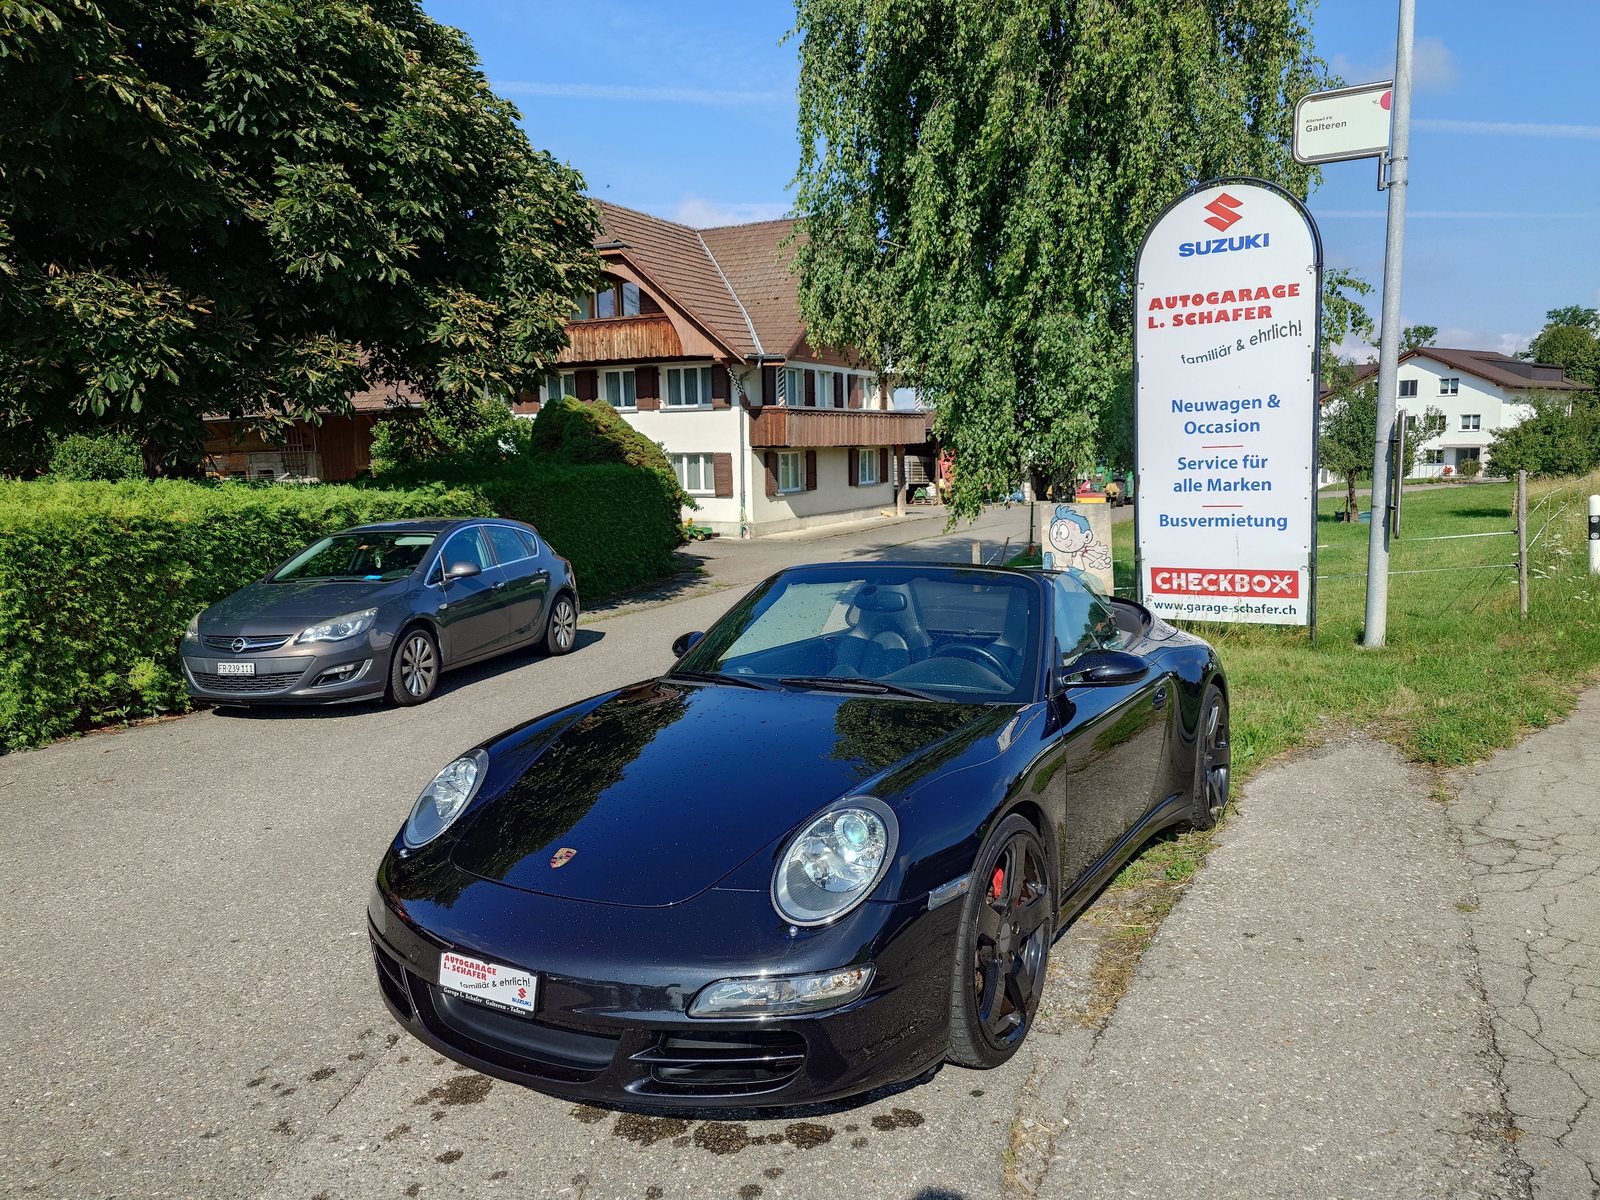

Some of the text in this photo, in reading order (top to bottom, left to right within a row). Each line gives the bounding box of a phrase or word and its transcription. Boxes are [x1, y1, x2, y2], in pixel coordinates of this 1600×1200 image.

[1305, 121, 1347, 132] Galteren
[1178, 232, 1270, 257] SUZUKI
[1148, 283, 1300, 311] AUTOGARAGE
[1148, 305, 1273, 329] L. SCHAFER
[1181, 319, 1302, 365] familiär & ehrlich!
[1171, 394, 1281, 414] Neuwagen &
[1184, 419, 1261, 435] Occasion
[1177, 454, 1268, 470] Service für
[1173, 477, 1272, 492] alle Marken
[1159, 513, 1288, 531] Busvermietung
[1155, 571, 1294, 594] CHECKBOX
[1153, 600, 1297, 616] www.garage-schafer.ch
[443, 962, 487, 981] L. SCHAFER
[444, 954, 497, 976] AUTOGARAGE
[491, 980, 497, 988] &
[499, 976, 531, 987] ehrlich!
[443, 986, 459, 997] Garage
[511, 997, 532, 1007] SUZUKI
